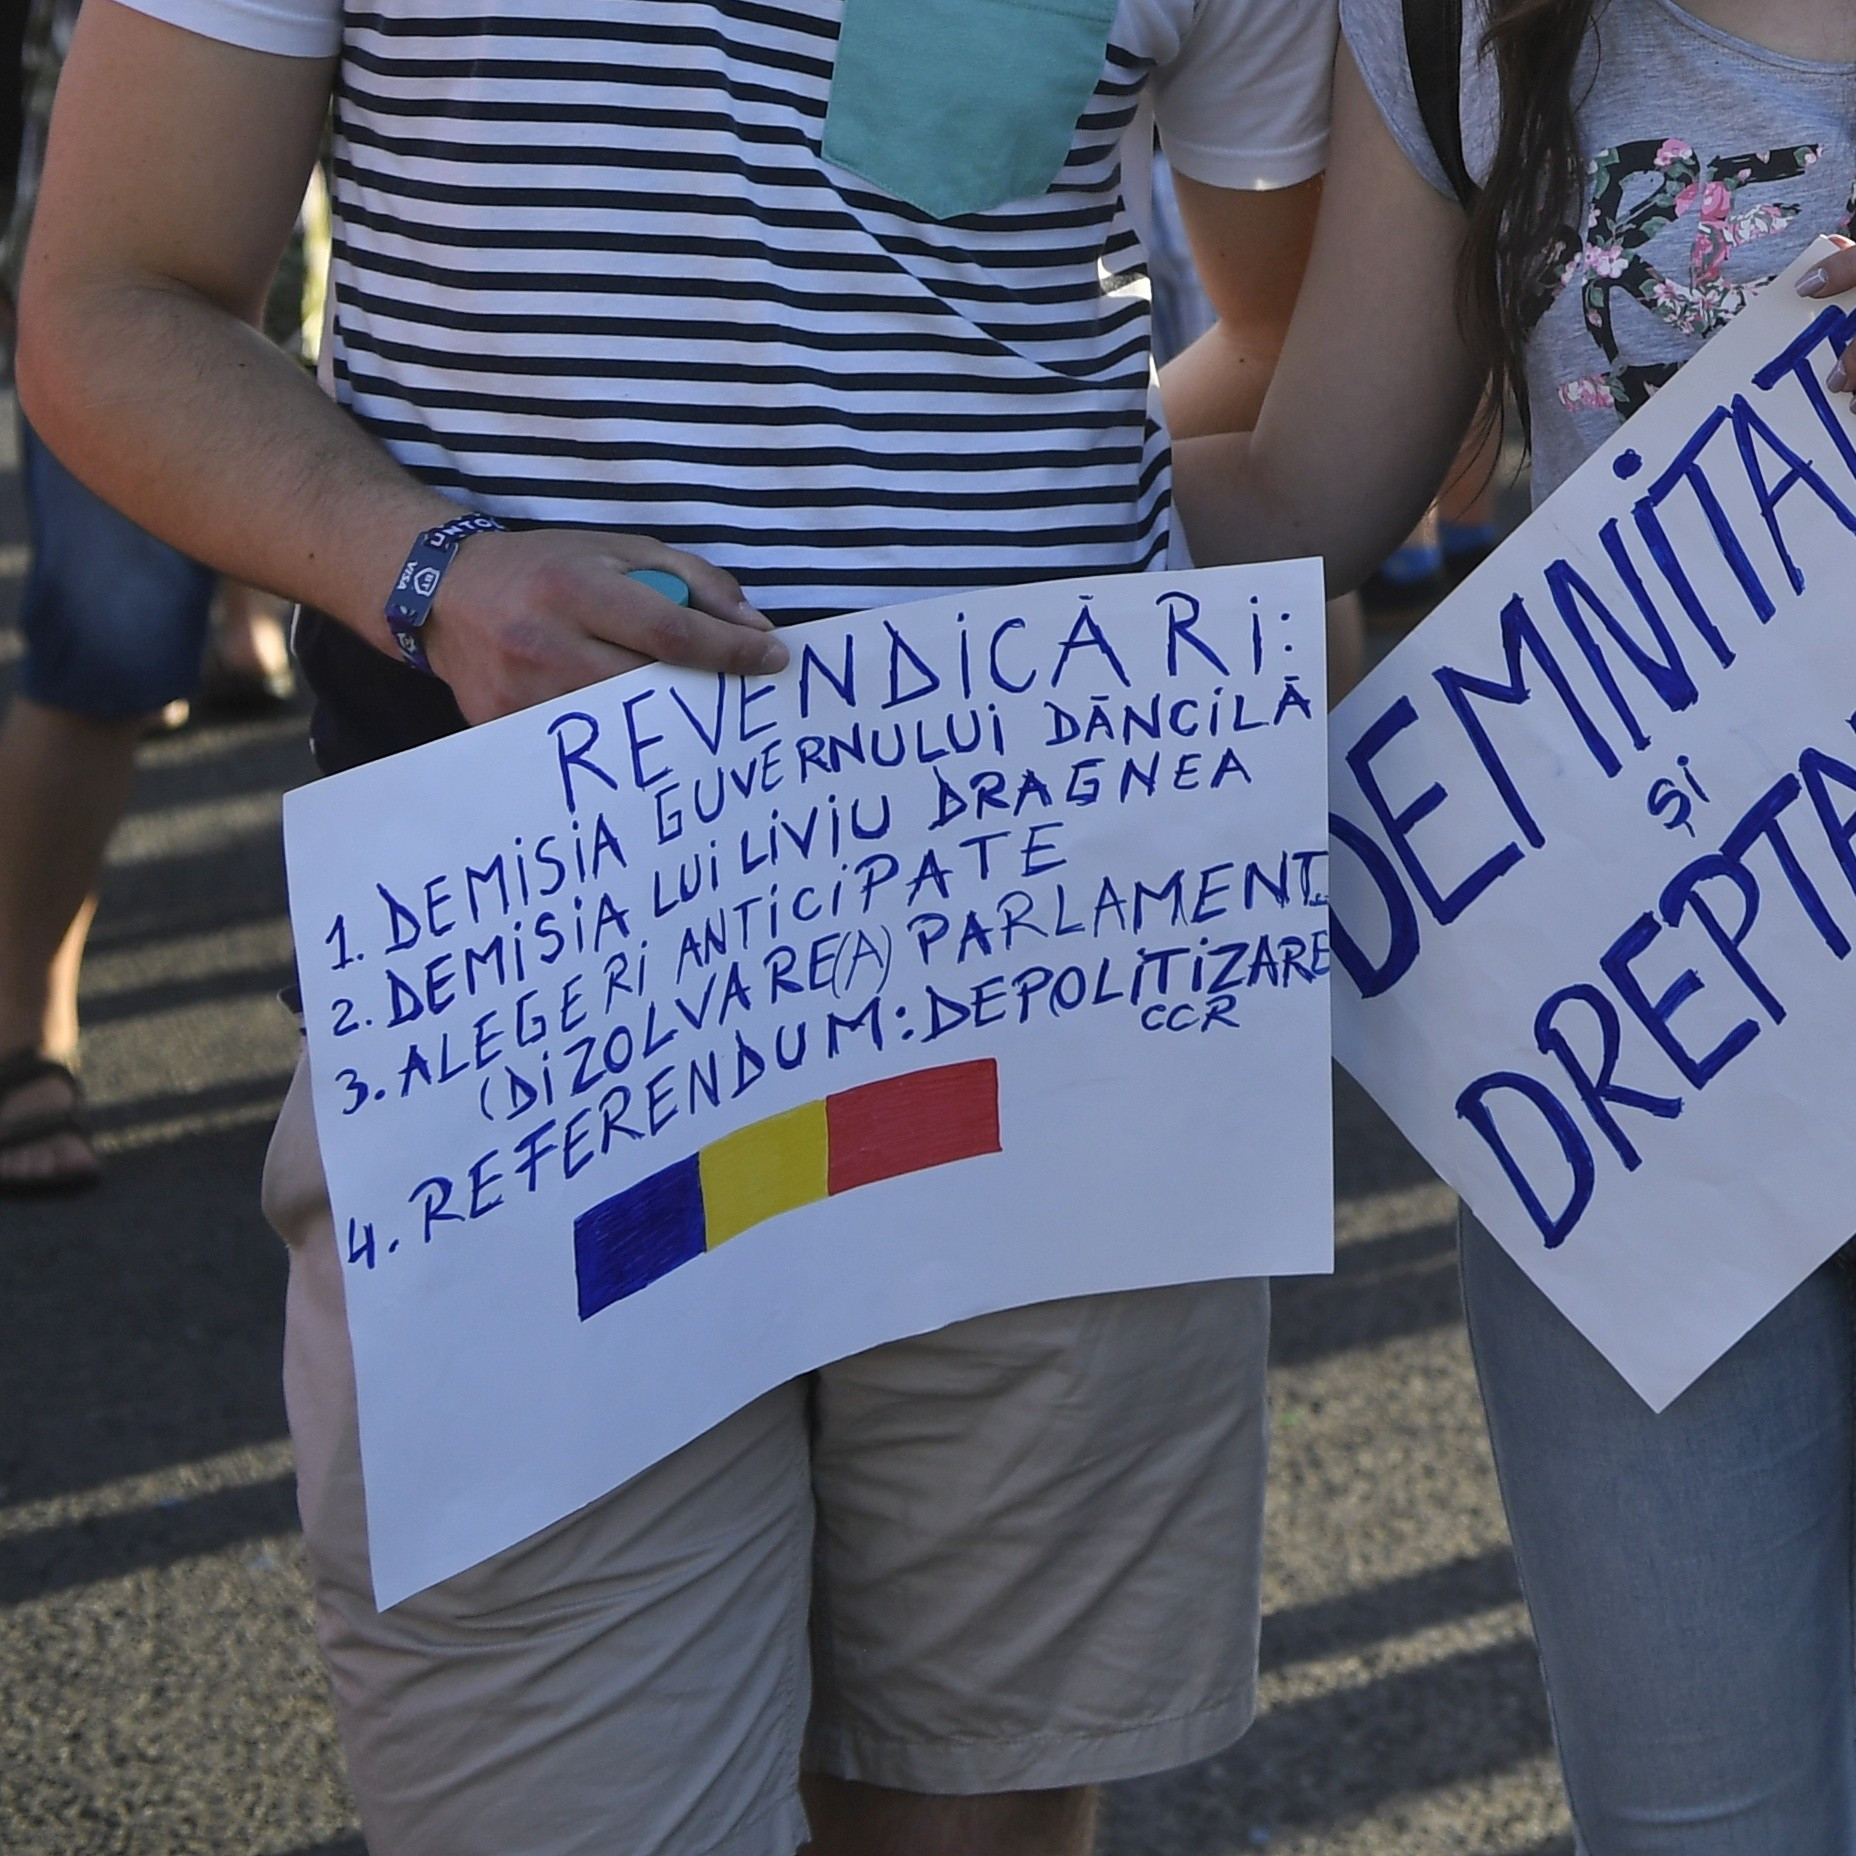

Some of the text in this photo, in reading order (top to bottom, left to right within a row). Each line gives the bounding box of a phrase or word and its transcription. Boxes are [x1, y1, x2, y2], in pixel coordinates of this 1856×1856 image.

[396, 561, 419, 591] VISA
[376, 812, 628, 955] DEMISIA
[654, 703, 1004, 844] GUVERNULUI
[387, 892, 630, 1028] DEMISIA
[653, 846, 719, 916] LUI
[742, 794, 891, 873] LIVIU
[928, 747, 1252, 831] DRAGNEA
[396, 939, 648, 1098] ALEGERI
[676, 821, 1067, 985] ANTICIPATE
[1141, 994, 1240, 1032] CCR
